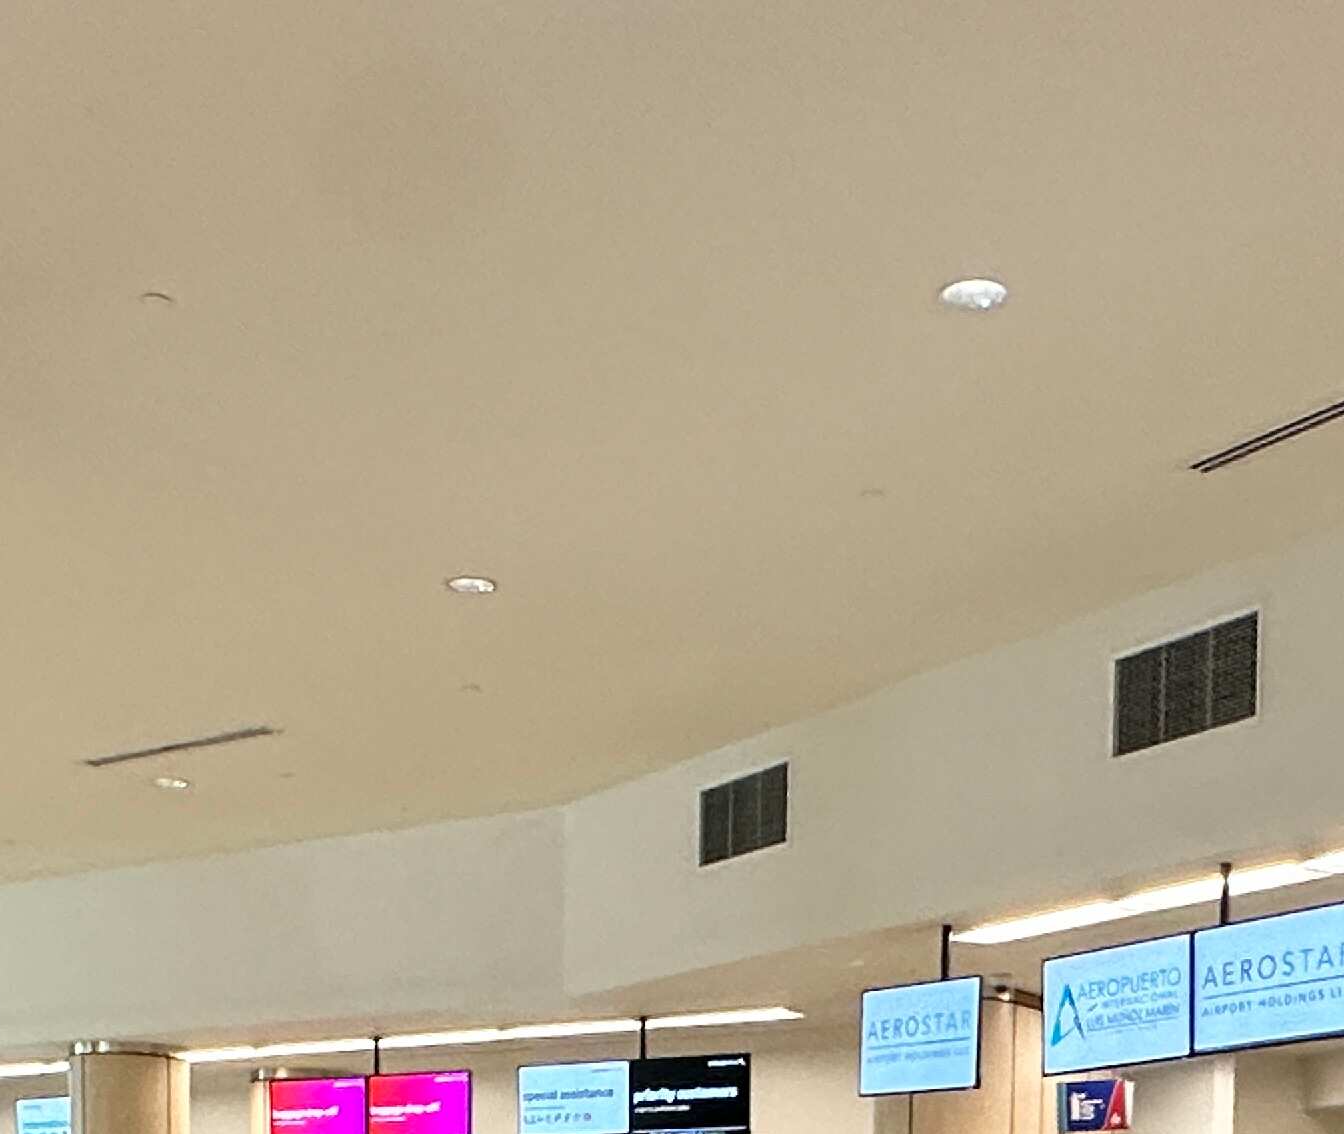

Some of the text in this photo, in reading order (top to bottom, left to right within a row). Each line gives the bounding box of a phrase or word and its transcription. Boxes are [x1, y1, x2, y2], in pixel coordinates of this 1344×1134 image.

[1078, 966, 1182, 1000] AEROPUERTO
[1201, 1000, 1253, 1018] AIRPORT
[1258, 987, 1326, 1009] HOLDINGS
[866, 1009, 972, 1041] AEROSTAR
